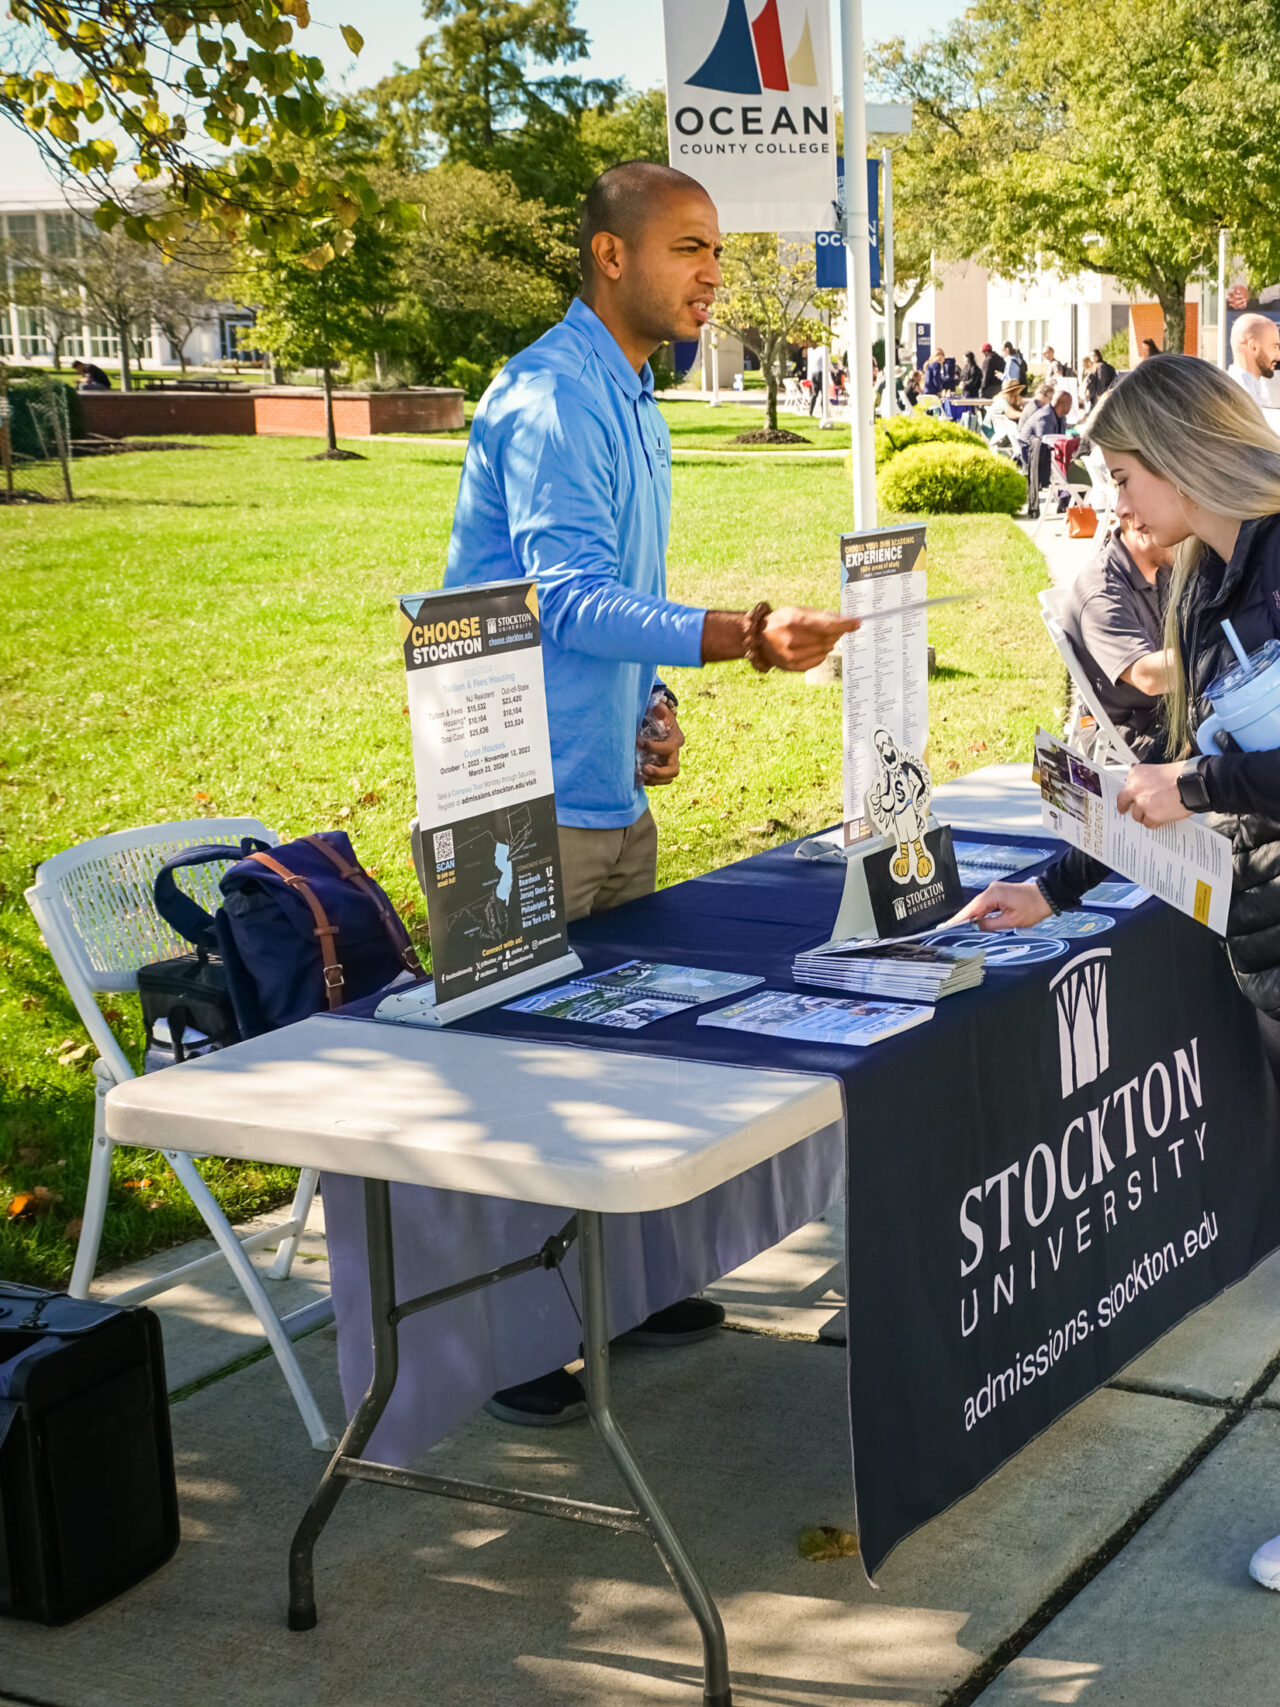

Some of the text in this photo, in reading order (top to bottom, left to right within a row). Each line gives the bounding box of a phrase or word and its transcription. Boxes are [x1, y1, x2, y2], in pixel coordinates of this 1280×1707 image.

[675, 106, 828, 135] OCEAN
[680, 142, 829, 154] COUNTY COLLEGE
[918, 325, 924, 335] 8
[846, 546, 903, 568] EXPERIENCE
[497, 613, 532, 627] STOCKTON
[412, 616, 481, 647] CHOOSE
[413, 637, 482, 665] STOCKTON
[489, 672, 516, 685] Housing
[475, 691, 495, 700] Resident
[502, 683, 530, 695] Out-of-State
[441, 765, 460, 774] October
[485, 752, 509, 763] November
[469, 768, 484, 776] March
[436, 859, 455, 873] SCAN
[906, 881, 945, 907] STOCKTON
[521, 899, 547, 915] Philadelphia
[908, 894, 946, 916] UNIVERSITY
[523, 920, 532, 928] New
[533, 916, 542, 925] York
[542, 912, 551, 922] City
[482, 943, 503, 956] Connect
[504, 939, 515, 948] with
[959, 1037, 1204, 1278] STOCKTON
[961, 1121, 1208, 1338] UNIVERSITY
[964, 1210, 1219, 1432] admissions.stockton.edu
